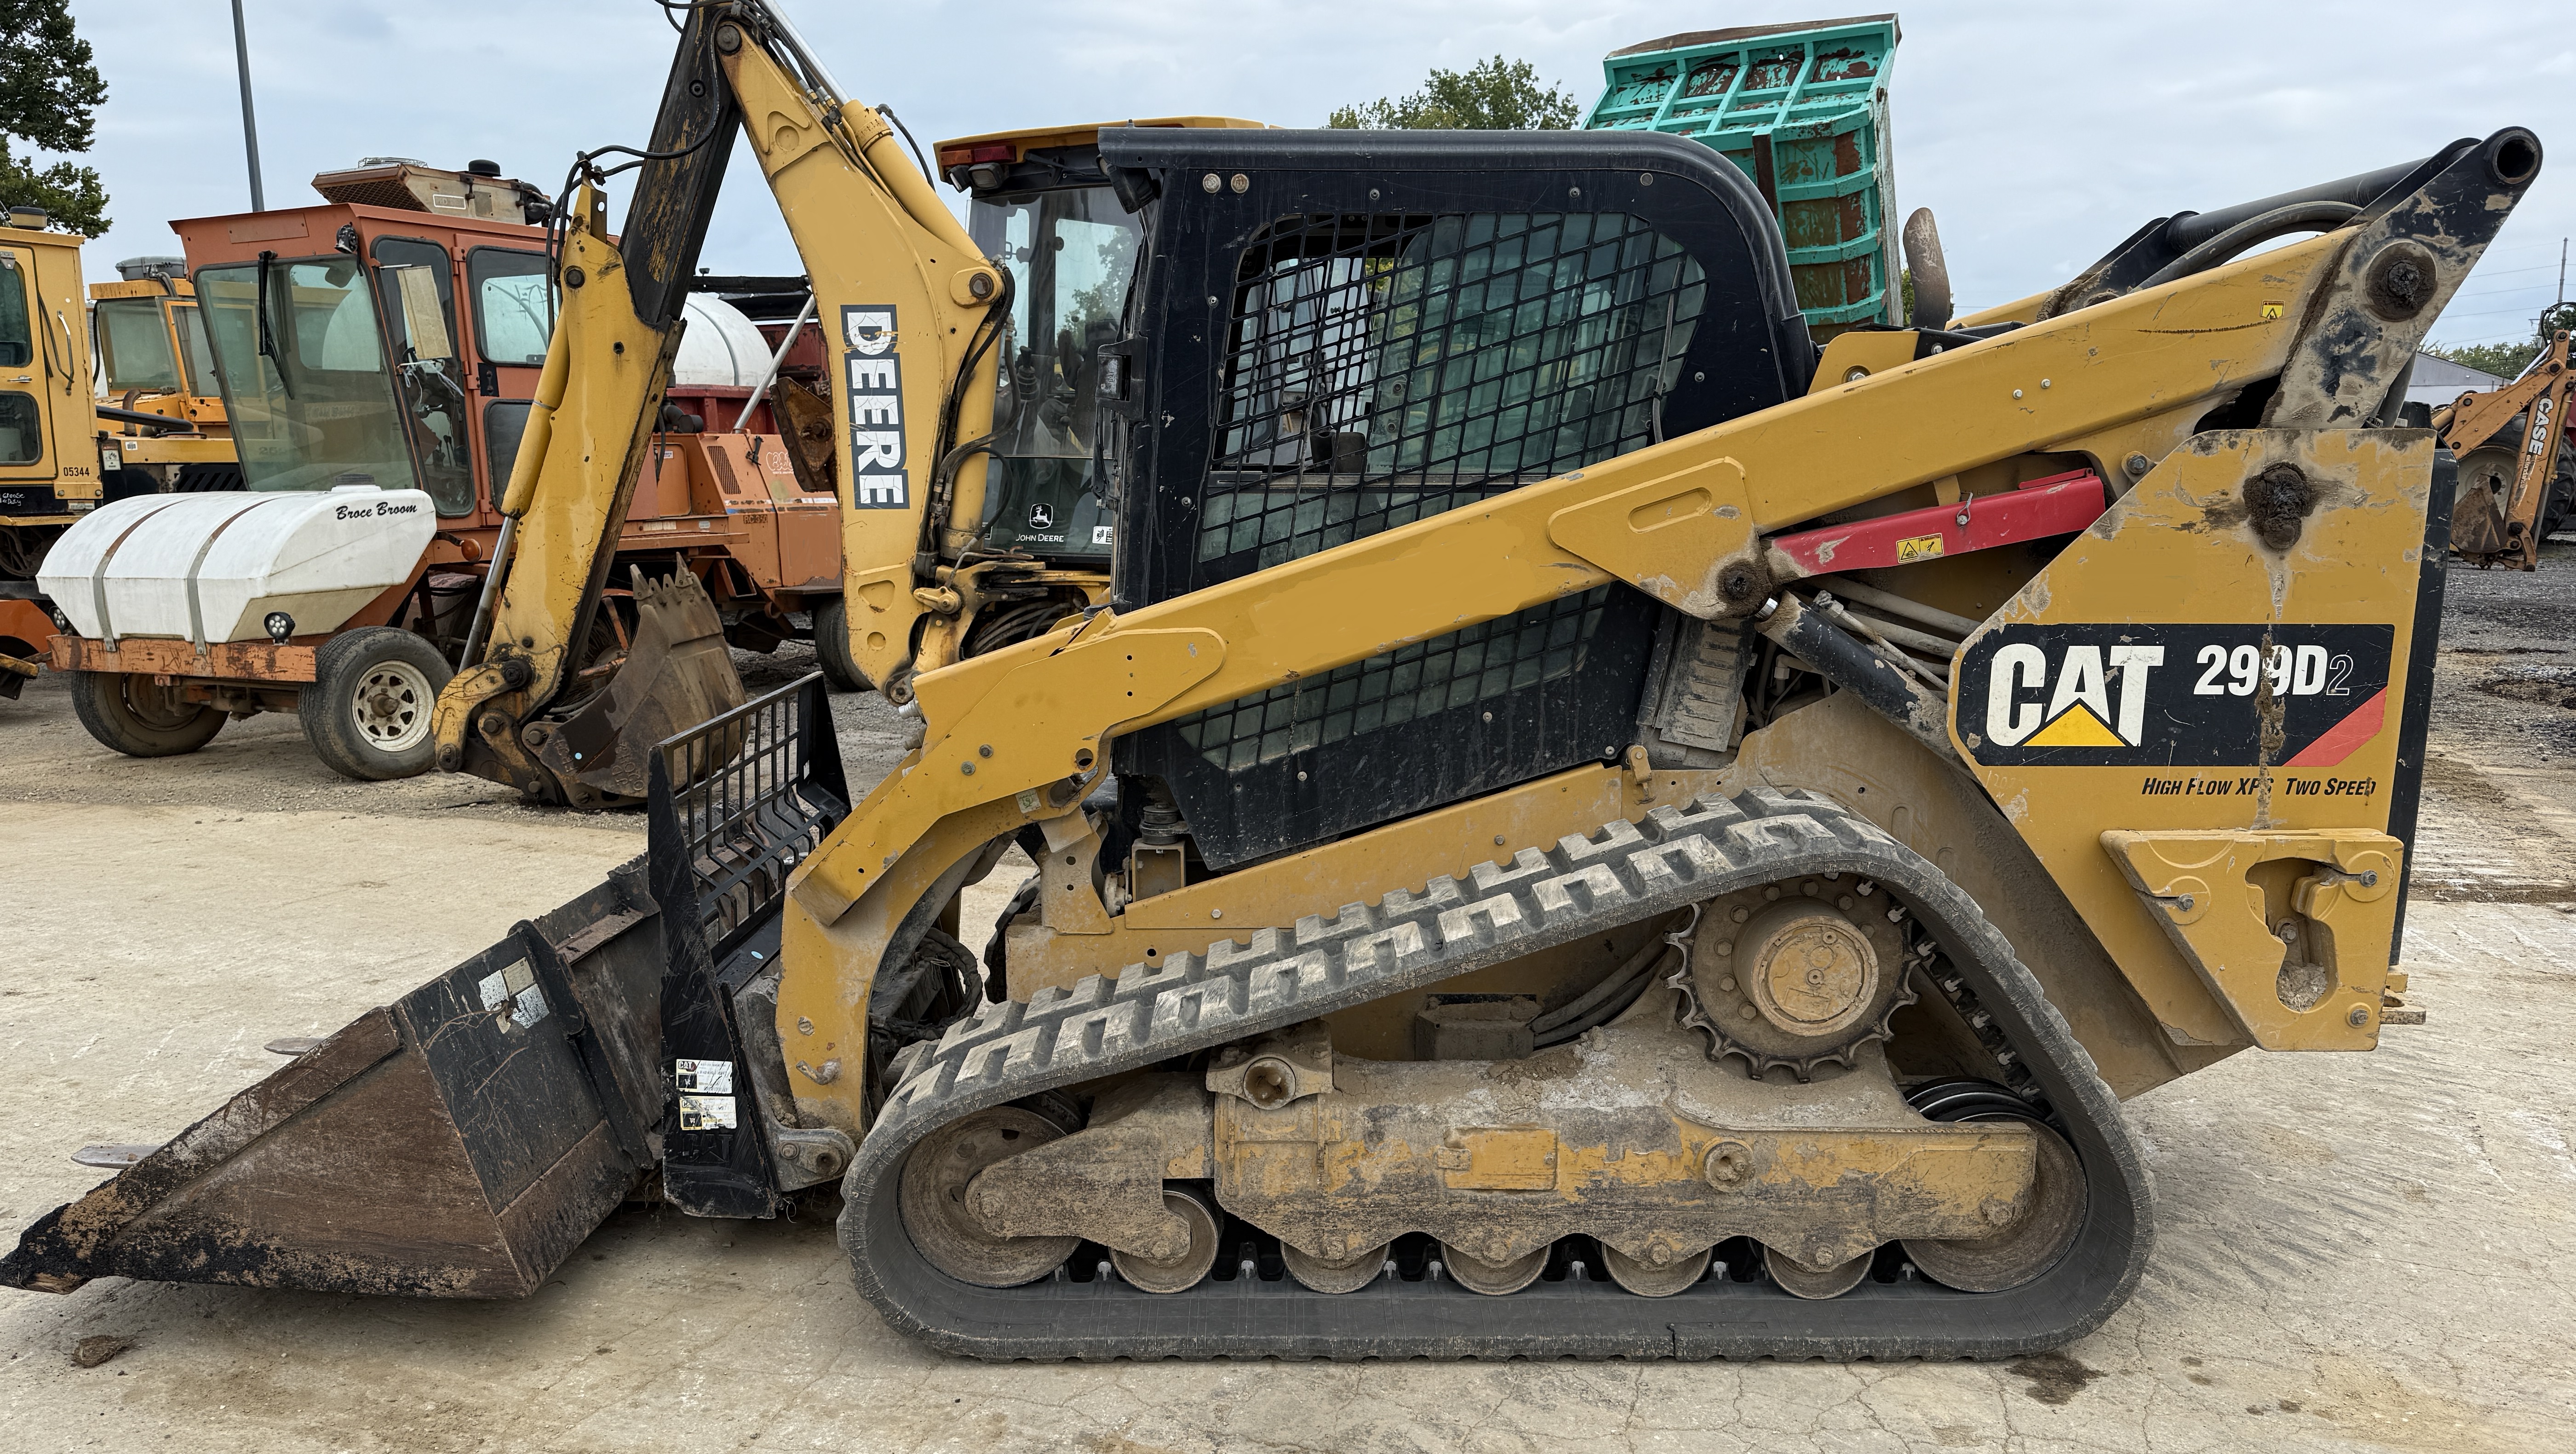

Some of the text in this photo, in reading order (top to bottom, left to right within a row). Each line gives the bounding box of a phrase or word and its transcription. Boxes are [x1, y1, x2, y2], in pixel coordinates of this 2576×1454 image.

[847, 312, 904, 504] DEERE
[2529, 397, 2553, 455] CASE
[63, 467, 90, 476] 05344
[336, 501, 417, 520] Broce Broom
[1038, 534, 1064, 542] DEERE
[1986, 644, 2165, 747] CAT
[678, 1061, 693, 1069] CAT
